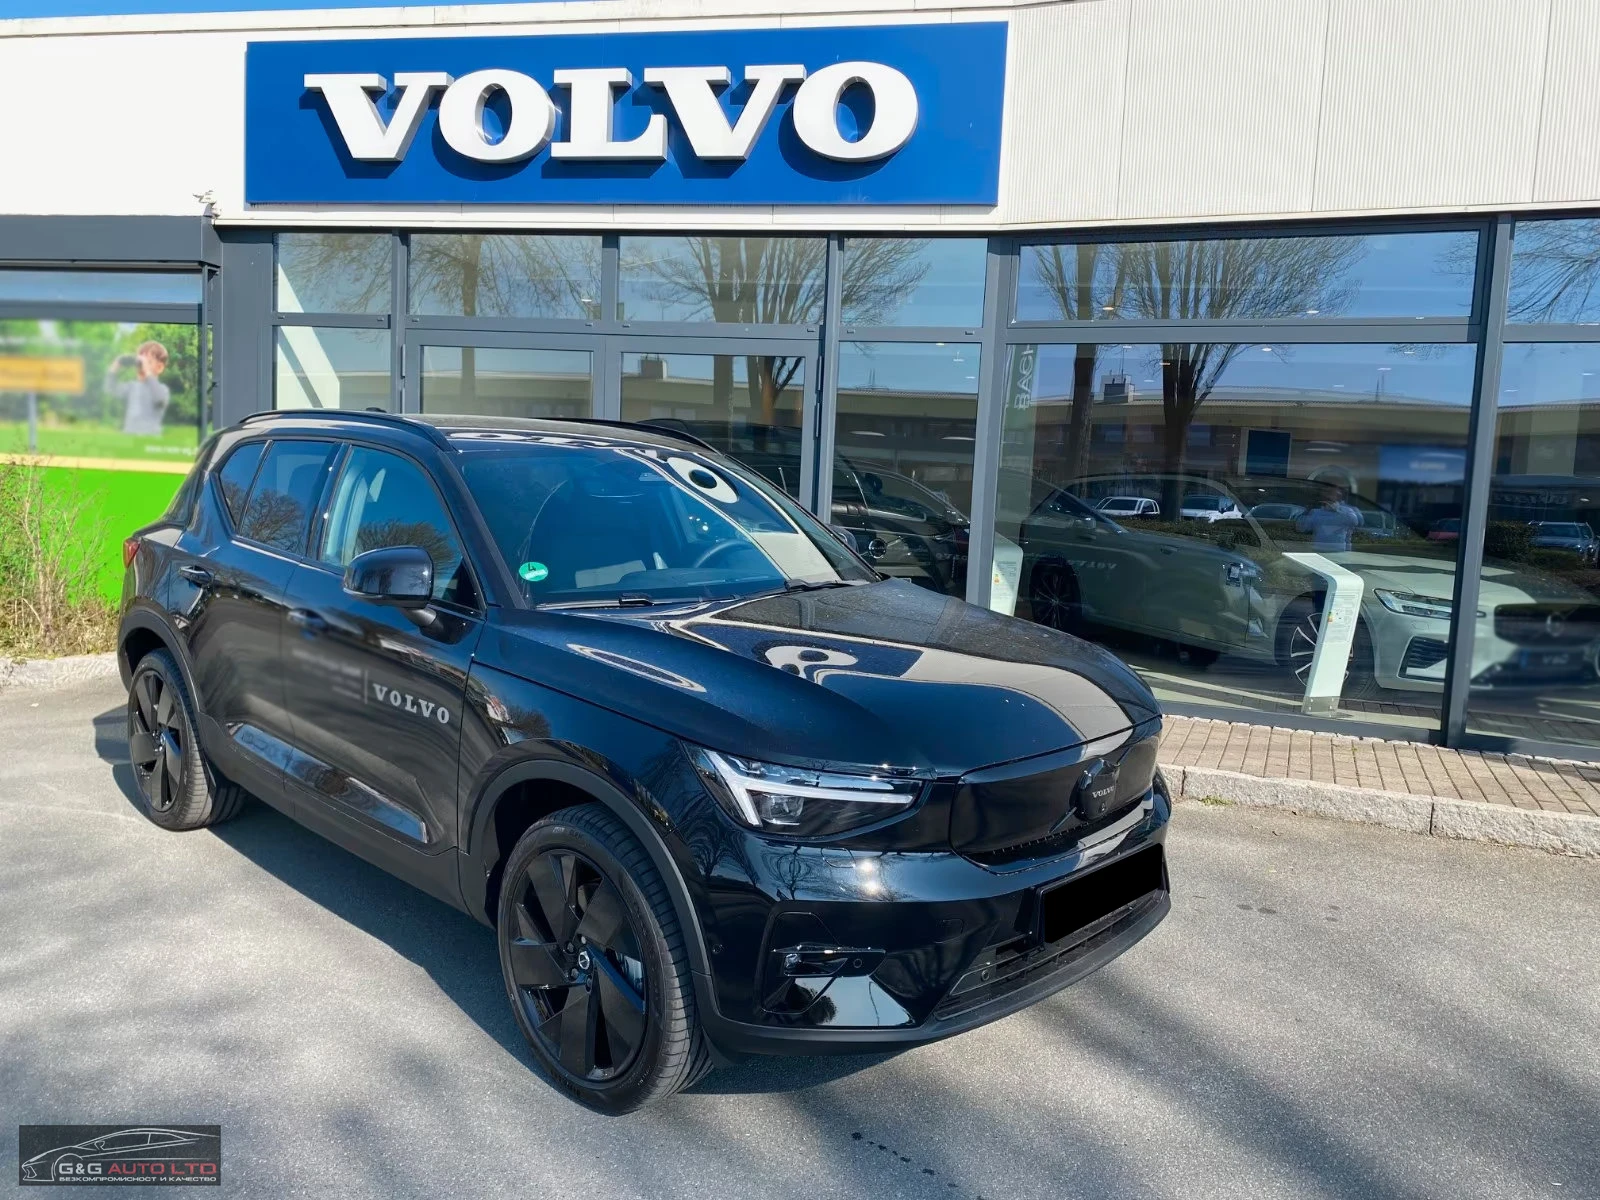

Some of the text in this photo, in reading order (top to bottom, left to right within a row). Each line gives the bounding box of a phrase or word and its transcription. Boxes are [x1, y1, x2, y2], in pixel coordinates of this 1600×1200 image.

[304, 61, 919, 164] VOLVO
[372, 683, 450, 724] VOLVO
[1092, 785, 1116, 798] VOLVO
